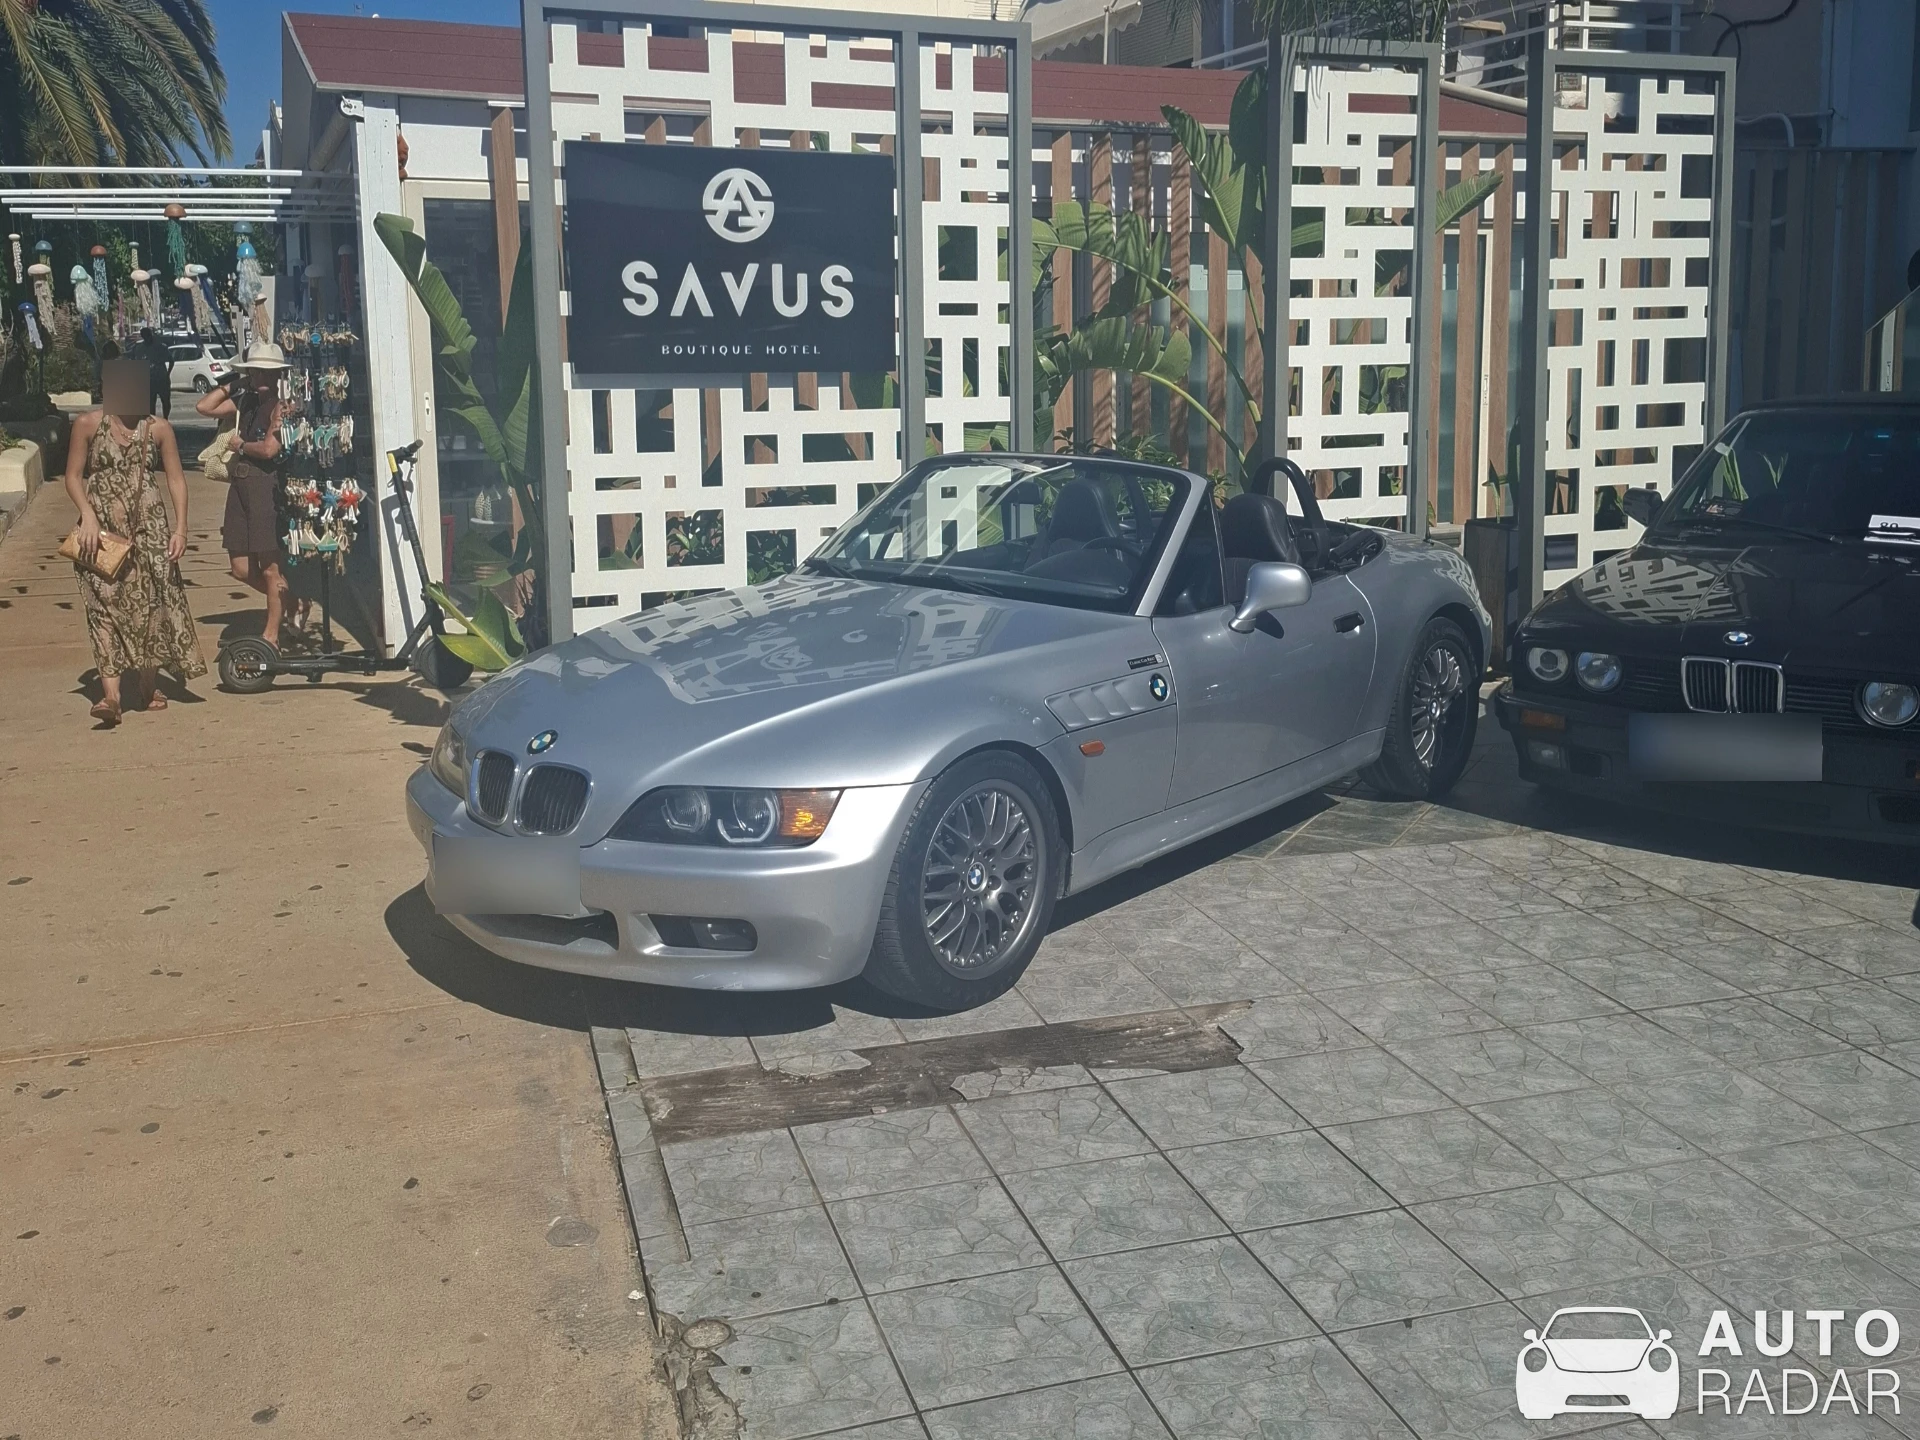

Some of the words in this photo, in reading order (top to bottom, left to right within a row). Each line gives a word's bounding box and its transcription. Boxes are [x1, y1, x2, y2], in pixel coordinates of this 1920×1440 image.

[621, 260, 854, 317] SAVUS
[661, 344, 752, 357] BOUTIQUE
[766, 344, 821, 355] HOTEL
